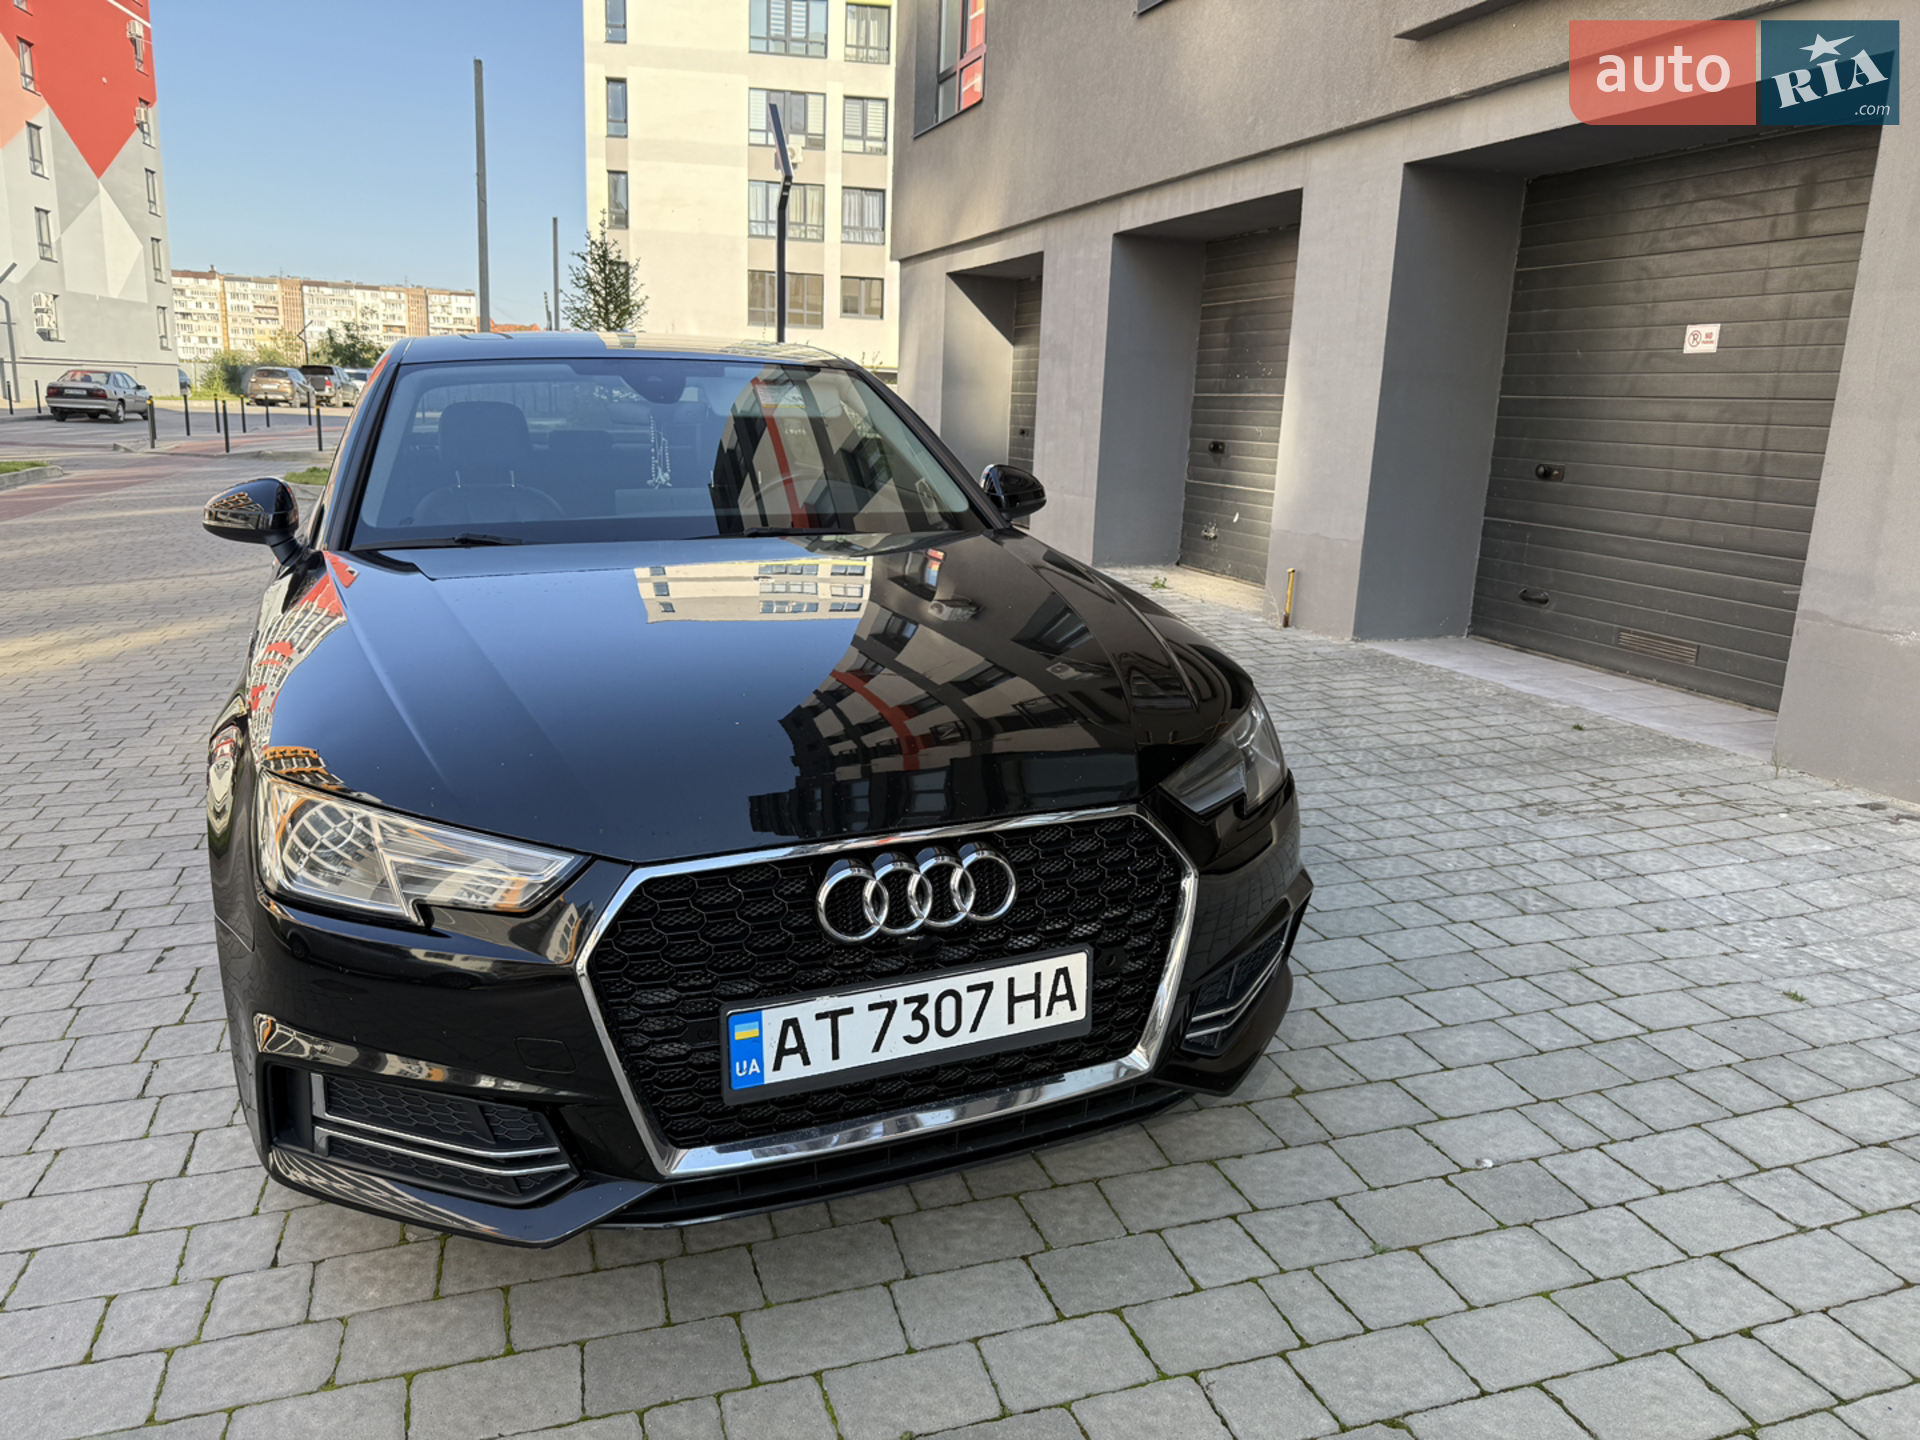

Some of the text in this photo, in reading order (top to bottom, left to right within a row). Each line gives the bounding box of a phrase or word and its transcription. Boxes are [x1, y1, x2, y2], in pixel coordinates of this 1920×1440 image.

[772, 966, 1077, 1072] AT 7307 HA
[735, 1058, 761, 1077] UA
